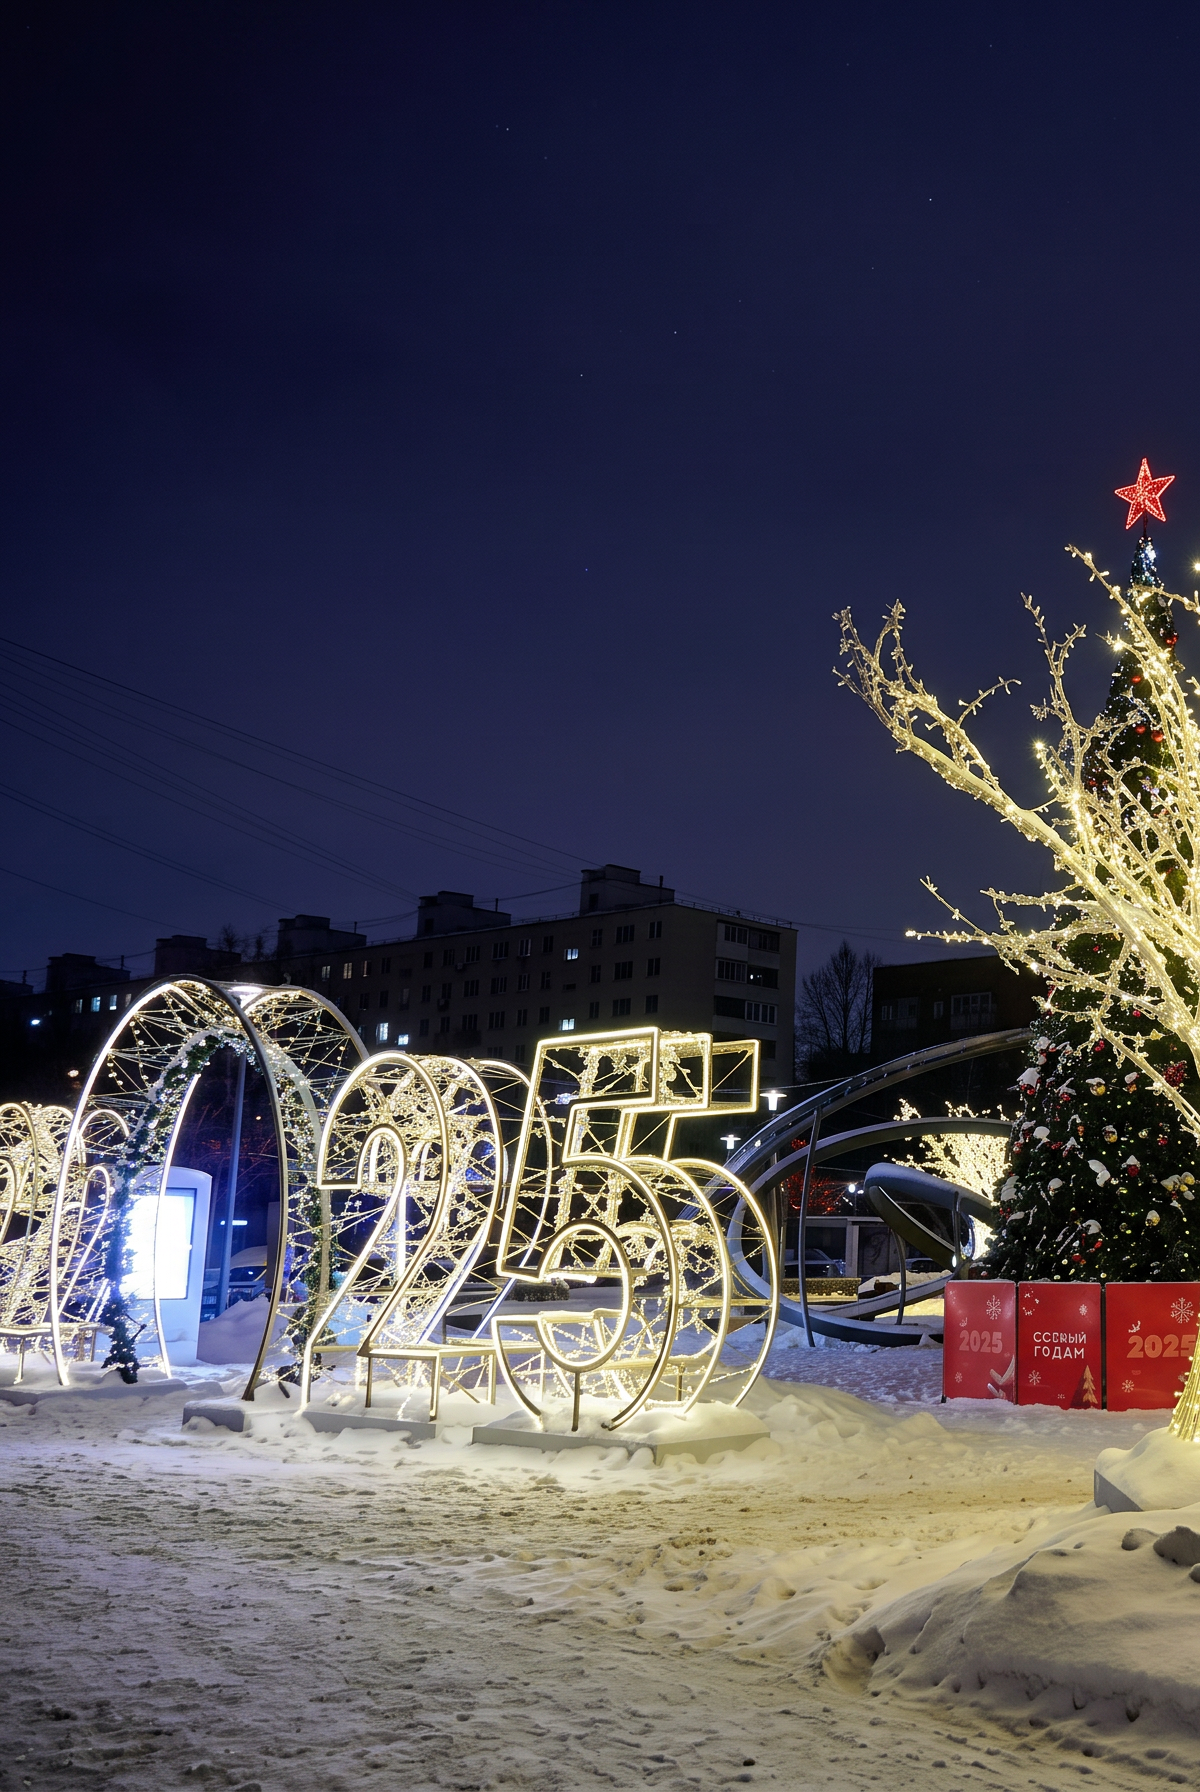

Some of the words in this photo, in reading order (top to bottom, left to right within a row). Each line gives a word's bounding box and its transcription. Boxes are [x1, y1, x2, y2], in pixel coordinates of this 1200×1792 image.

[959, 1330, 1003, 1354] 2025
[1034, 1346, 1085, 1360] ГОДАМ
[1126, 1334, 1196, 1358] 2025
